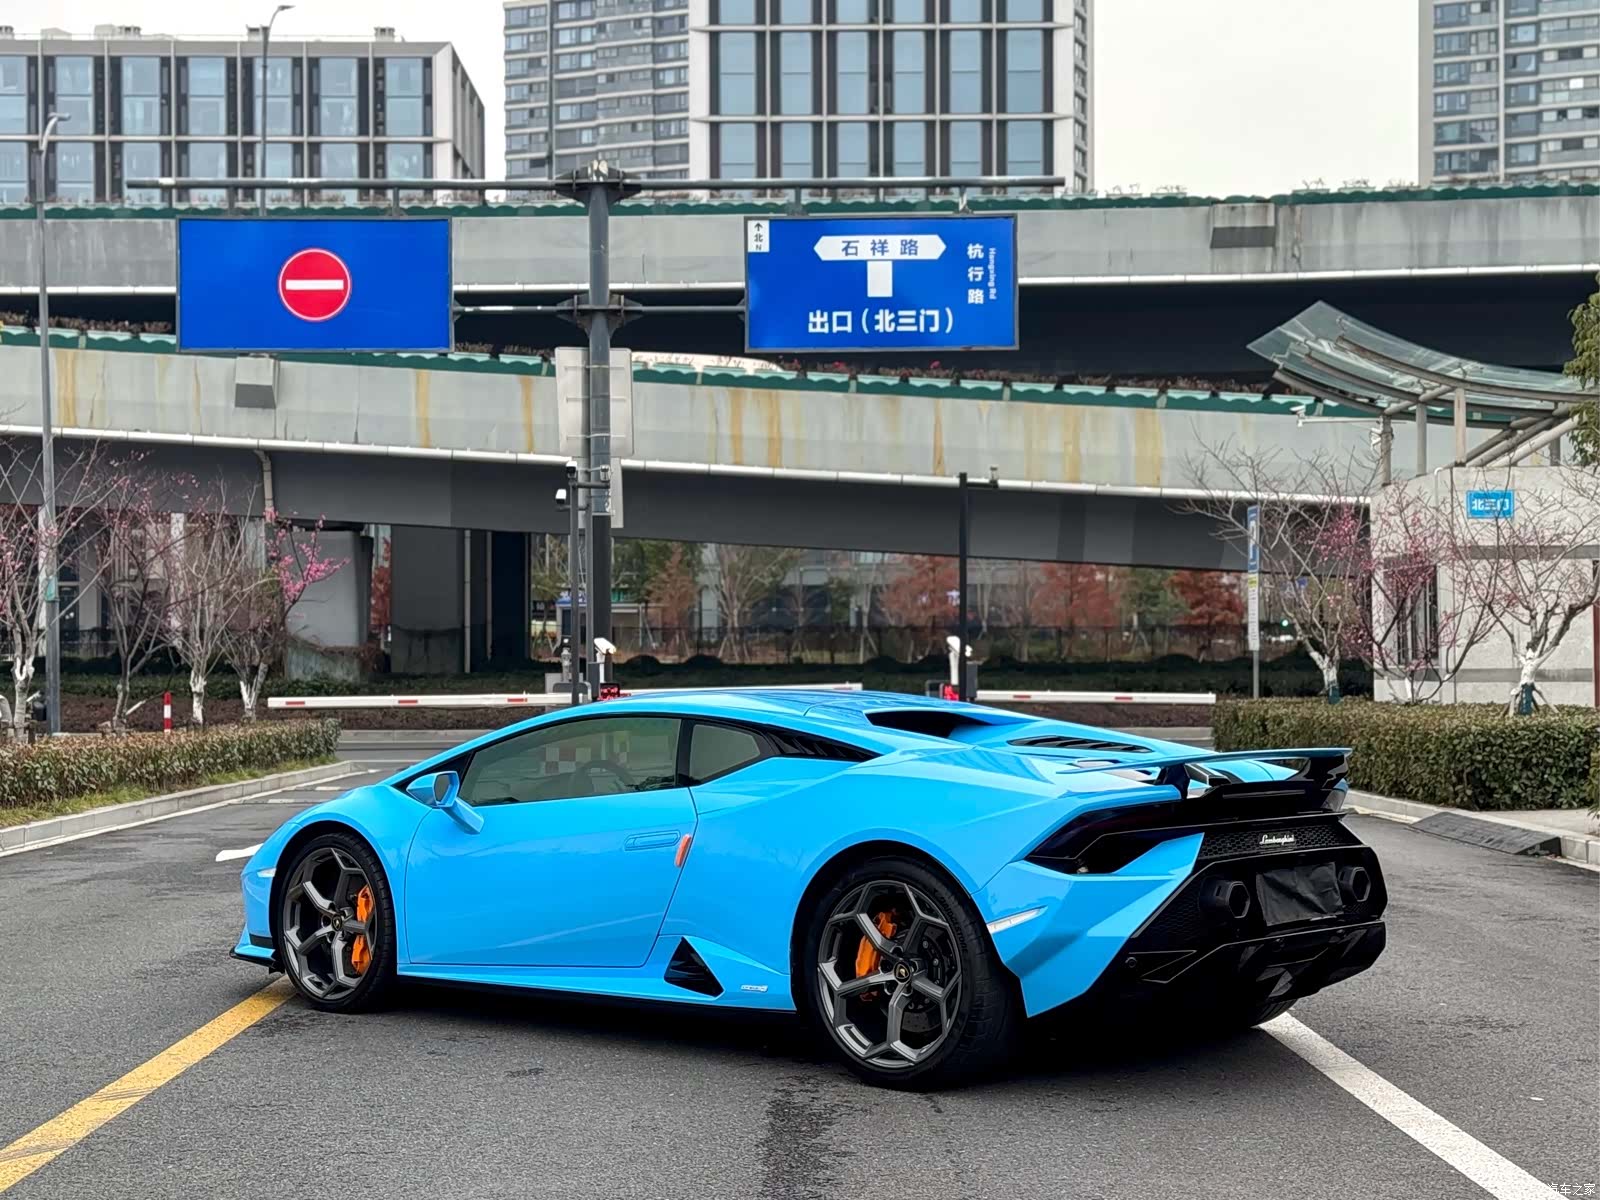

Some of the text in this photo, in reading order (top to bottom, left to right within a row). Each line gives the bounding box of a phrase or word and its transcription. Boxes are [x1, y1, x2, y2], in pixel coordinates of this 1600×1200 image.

[753, 233, 764, 242] 北
[841, 239, 919, 257] 石祥路
[967, 243, 984, 304] 杭行路
[1471, 498, 1510, 511] 北三门
